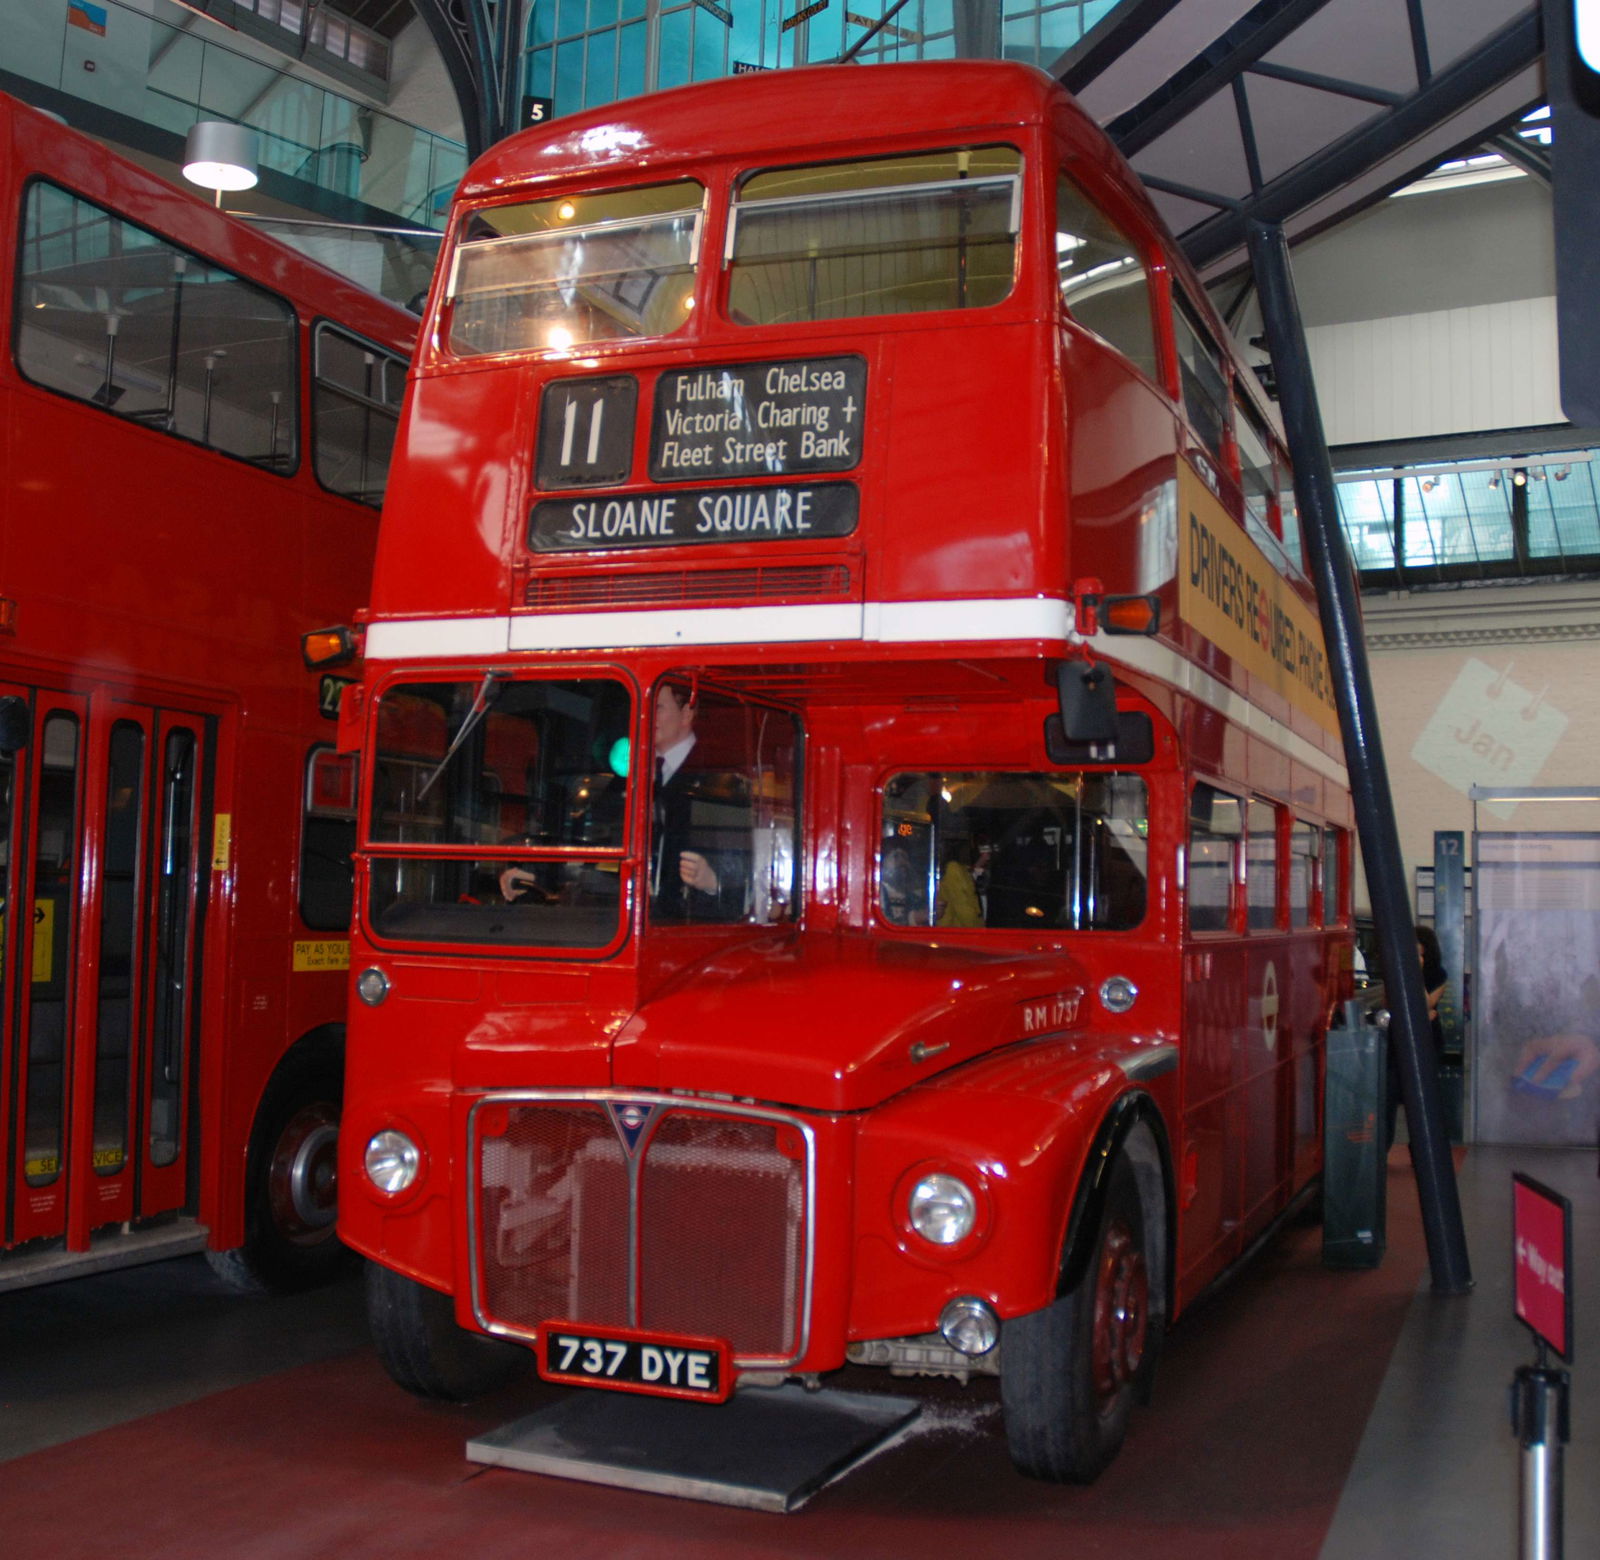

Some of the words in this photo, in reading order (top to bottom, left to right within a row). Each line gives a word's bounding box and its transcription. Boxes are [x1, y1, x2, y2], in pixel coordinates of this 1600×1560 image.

[531, 103, 543, 120] 5
[676, 375, 745, 402] Fulham
[765, 366, 846, 395] Chelsea
[560, 398, 604, 466] 11
[665, 409, 741, 436] Victoria
[757, 402, 830, 432] Charing
[661, 441, 713, 468] Fleet
[722, 437, 787, 464] Street
[800, 431, 850, 459] Bank
[570, 499, 676, 538] SLOANE
[696, 492, 813, 534] SQUARE
[1190, 511, 1243, 629] DRIVERS
[1454, 719, 1516, 771] Jan
[1439, 839, 1459, 856] 12
[296, 943, 310, 954] PAY
[314, 943, 324, 954] AS
[328, 943, 344, 955] YOU
[1024, 1005, 1047, 1031] RM
[1052, 1000, 1080, 1025] 1737
[558, 1337, 628, 1377] 737
[641, 1346, 711, 1389] DYE
